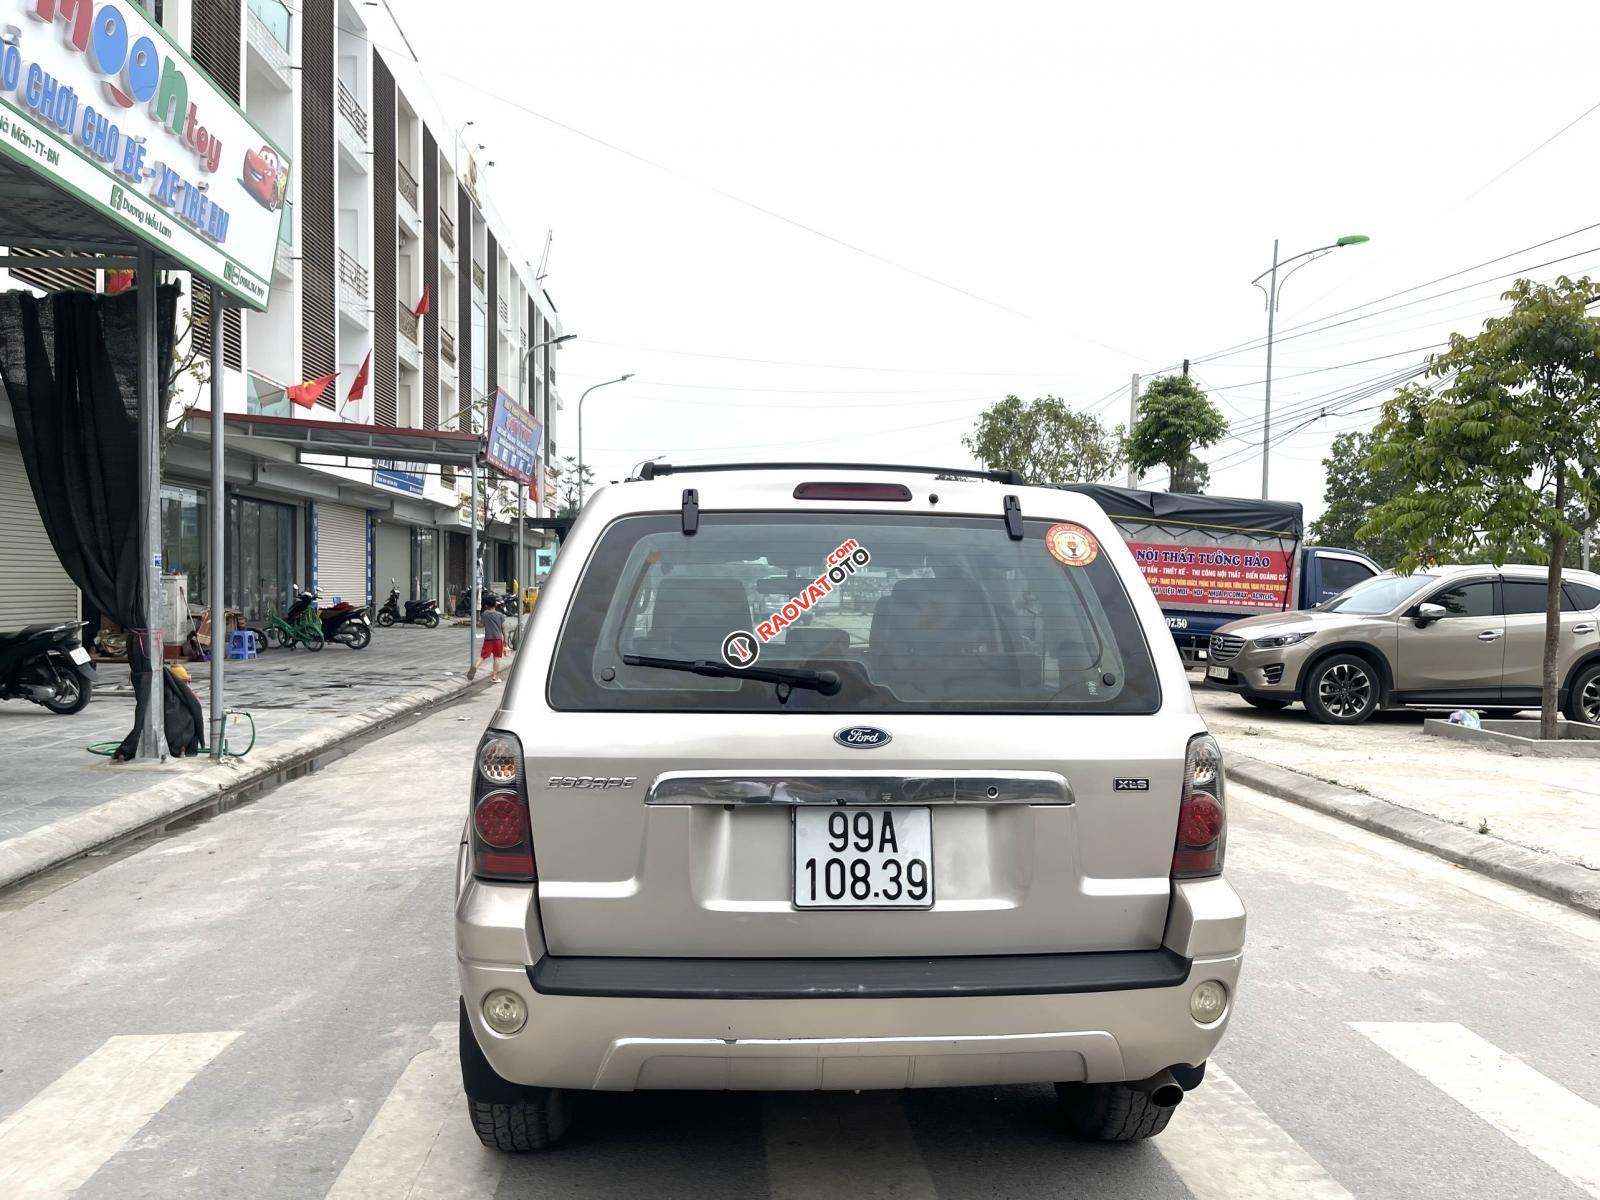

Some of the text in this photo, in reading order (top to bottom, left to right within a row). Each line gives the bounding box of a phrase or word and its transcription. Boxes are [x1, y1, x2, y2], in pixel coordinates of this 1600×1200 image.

[25, 62, 79, 134] CHƠI
[81, 105, 120, 163] CHO
[119, 134, 147, 184] BÉ
[155, 160, 181, 208] XE
[1137, 547, 1159, 564] NỘI
[1161, 546, 1195, 563] THẤT
[1244, 552, 1271, 568] HẢO
[847, 729, 879, 743] Ford
[545, 776, 638, 790] ESCAPE
[1117, 780, 1148, 789] XLS
[828, 811, 898, 853] 99A
[805, 858, 928, 901] 108.39
